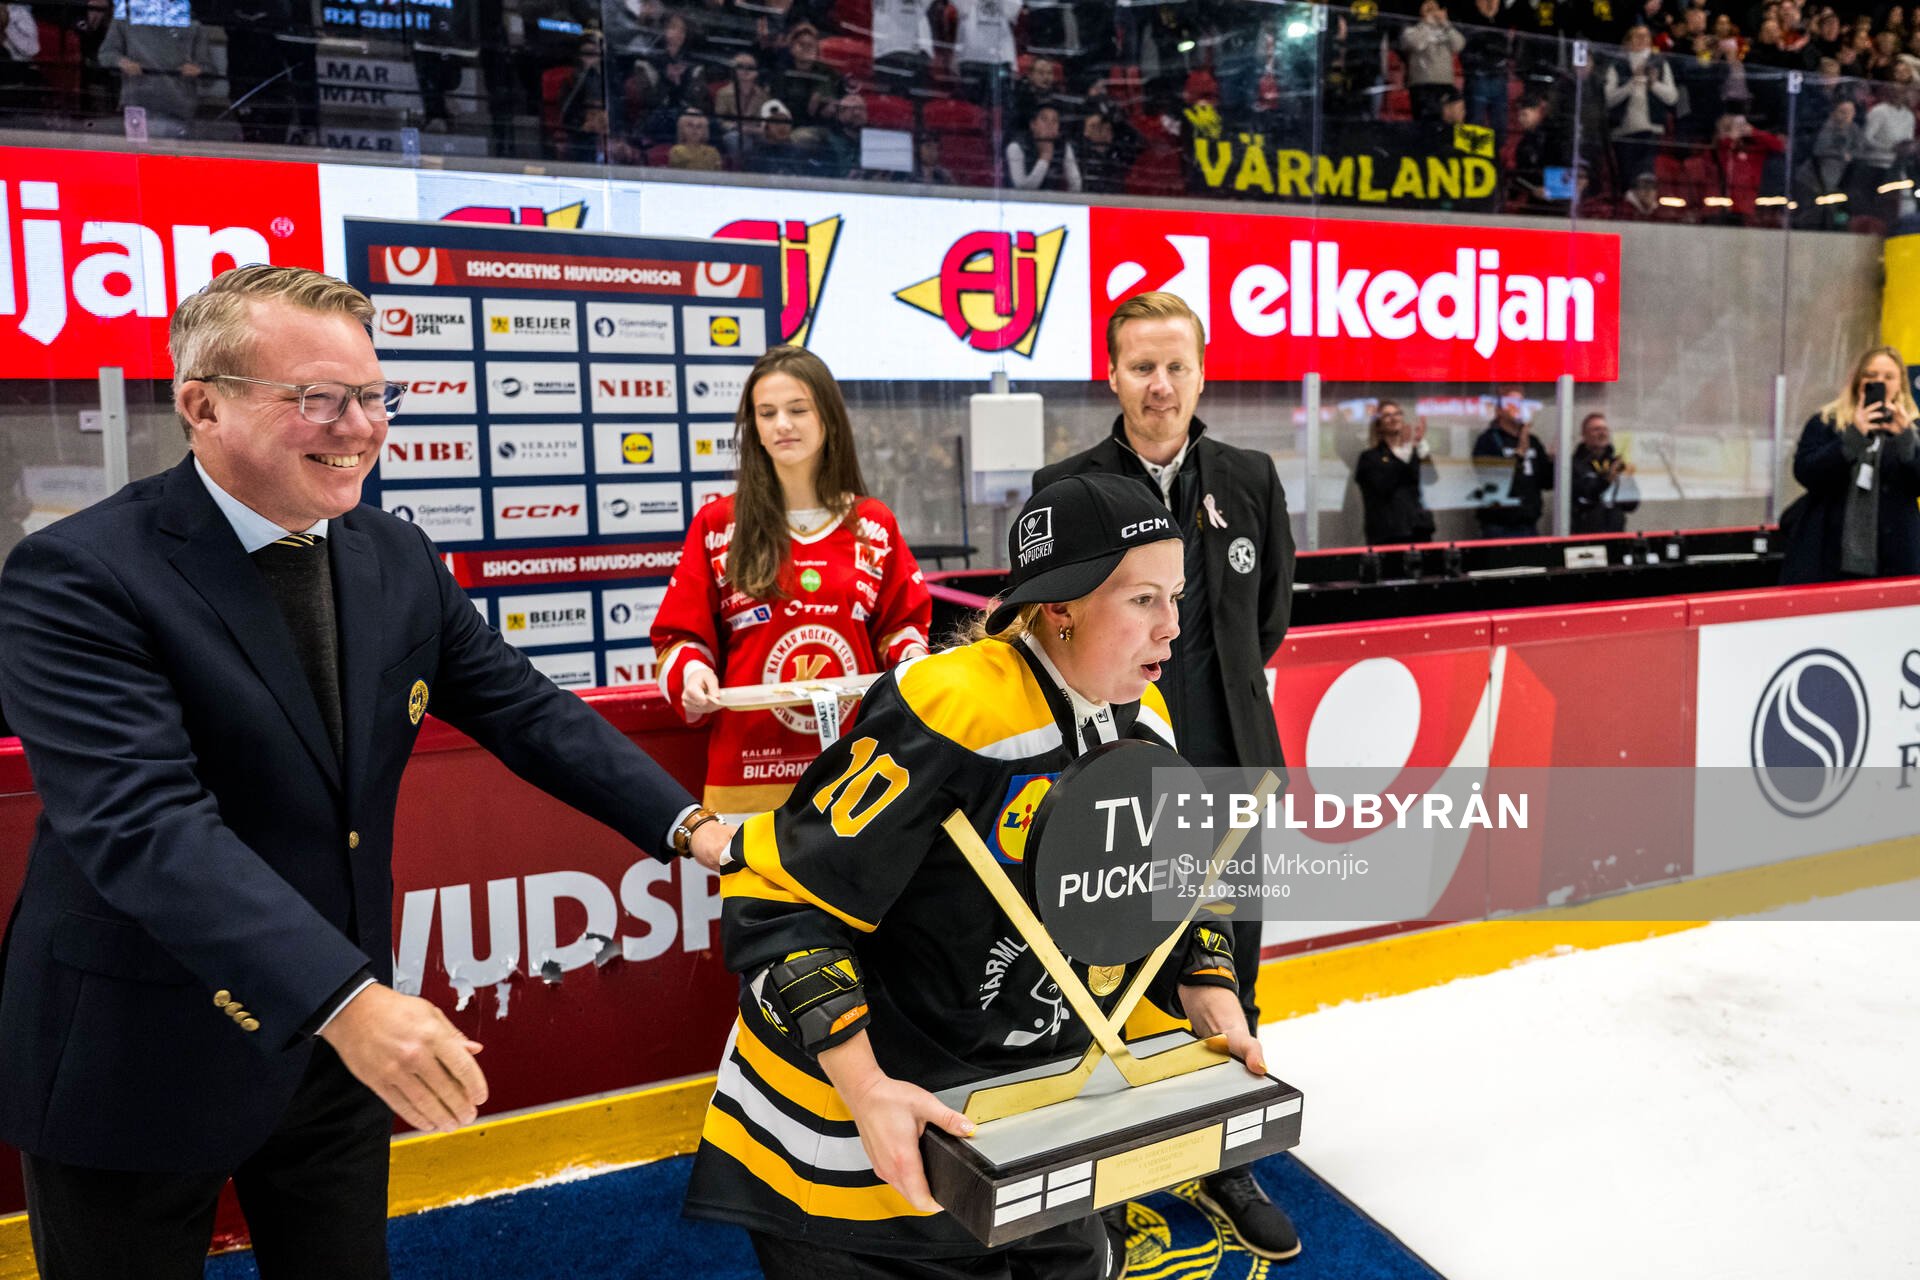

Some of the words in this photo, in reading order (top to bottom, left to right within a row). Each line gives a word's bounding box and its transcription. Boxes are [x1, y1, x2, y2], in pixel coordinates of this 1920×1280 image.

[1194, 132, 1498, 202] VÄRMLAND
[0, 180, 271, 346] jan
[466, 260, 562, 281] ISHOCKEYNS
[564, 265, 682, 287] HUVUDSPONSOR
[1229, 239, 1594, 359] elkedjan
[415, 313, 466, 325] SVENSKA
[514, 316, 571, 331] BEIJER
[415, 324, 442, 335] SPEL
[598, 380, 671, 398] NIBE
[387, 442, 473, 462] NIBE
[520, 440, 578, 450] SERAFIM
[417, 504, 476, 515] Gjensidige
[501, 504, 580, 519] CCM
[1121, 517, 1169, 539] CCM
[483, 557, 576, 578] ISHOCKEYNS
[579, 551, 683, 573] HUVUDSPONSO
[530, 608, 587, 623] BEIJER
[804, 604, 838, 614] TTM
[767, 633, 797, 674] KALMAR
[801, 628, 839, 646] HOCKEY
[838, 645, 855, 672] CLUB
[742, 747, 783, 757] KALMAR
[743, 760, 814, 779] BILFÖRM
[812, 736, 910, 838] 10
[1094, 792, 1169, 853] TV
[1058, 854, 1189, 908] PUCKEN
